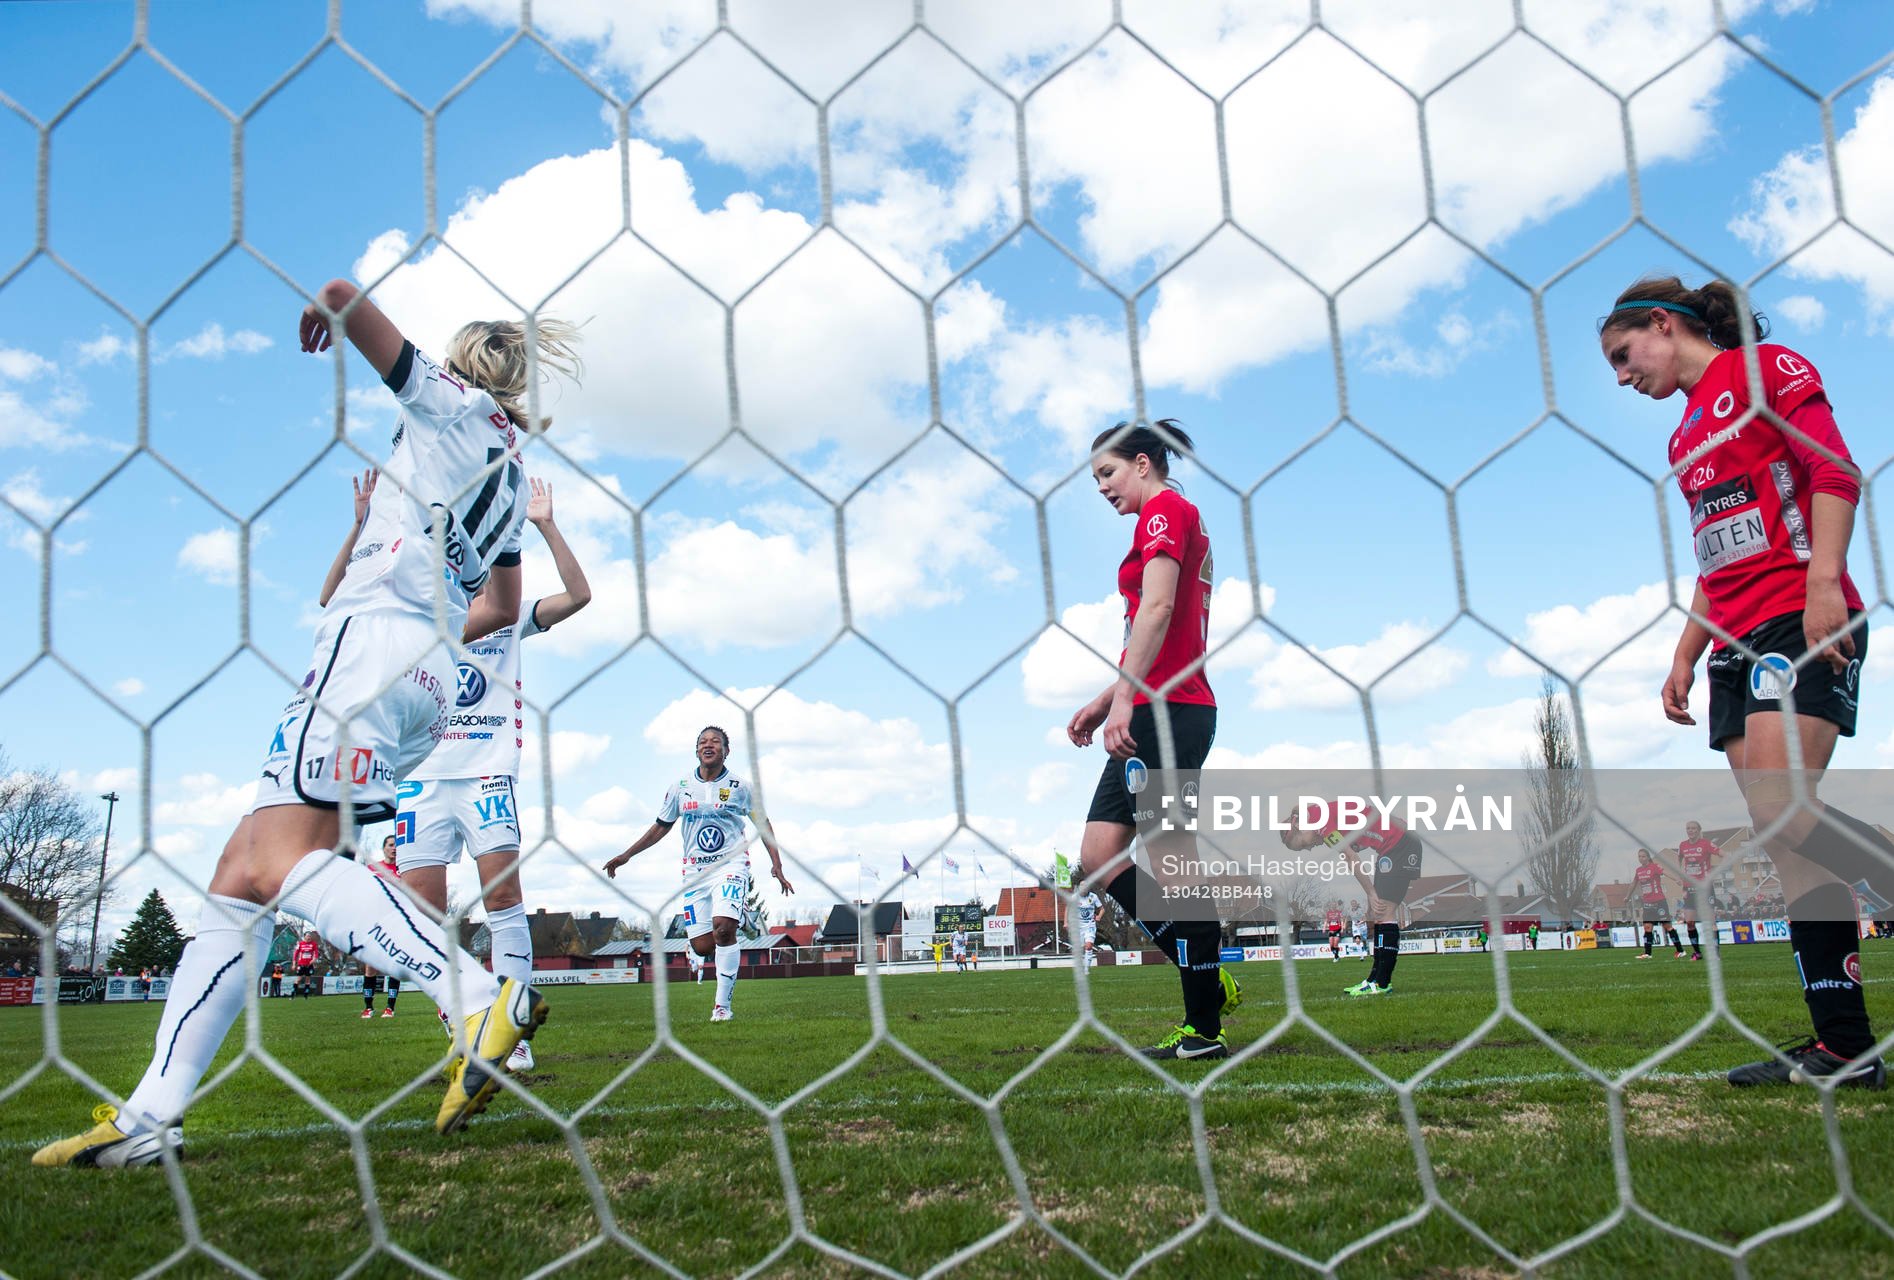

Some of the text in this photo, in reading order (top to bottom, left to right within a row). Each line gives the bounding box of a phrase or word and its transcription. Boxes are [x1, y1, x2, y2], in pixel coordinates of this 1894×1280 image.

[1704, 491, 1748, 515] TYRES
[1794, 517, 1809, 549] ERNST
[468, 647, 505, 655] RUPPEN
[443, 732, 494, 740] INTERSPORT
[306, 756, 326, 780] 17
[473, 795, 513, 823] VK
[722, 884, 741, 899] VK
[988, 920, 1007, 929] EKO
[1763, 921, 1787, 937] TIPS
[1257, 947, 1317, 959] INTEPORT
[1810, 979, 1854, 992] mitre
